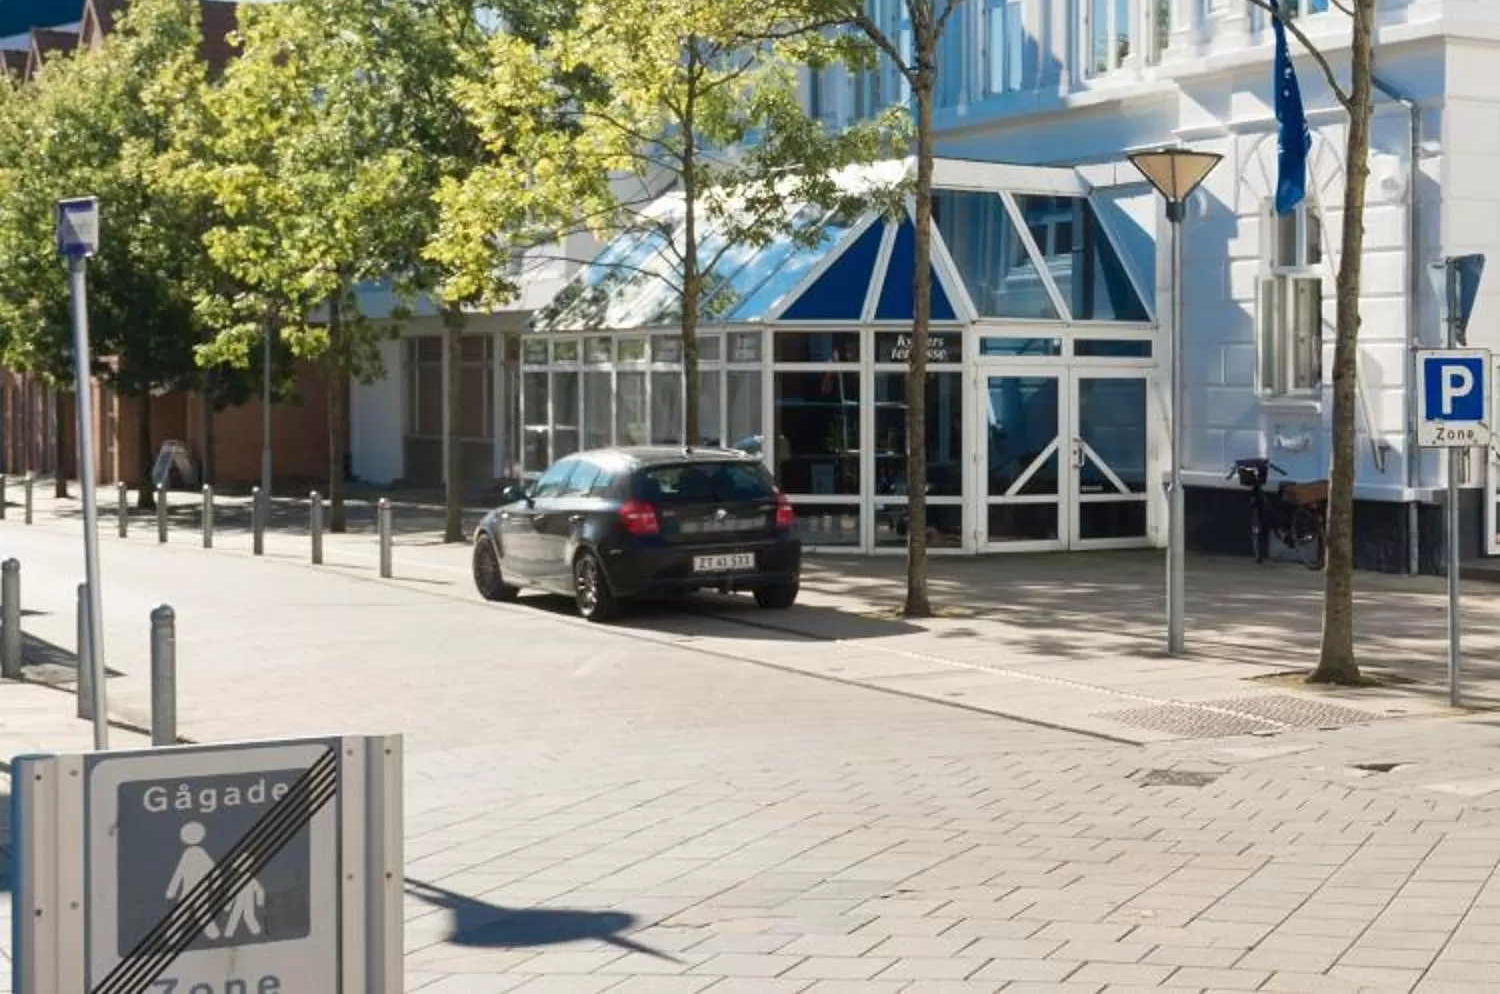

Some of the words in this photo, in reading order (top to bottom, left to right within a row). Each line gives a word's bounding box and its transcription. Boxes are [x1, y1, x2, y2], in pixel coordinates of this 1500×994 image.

[1441, 365, 1474, 414] P
[1436, 427, 1475, 441] Zone
[143, 777, 290, 813] Gågade
